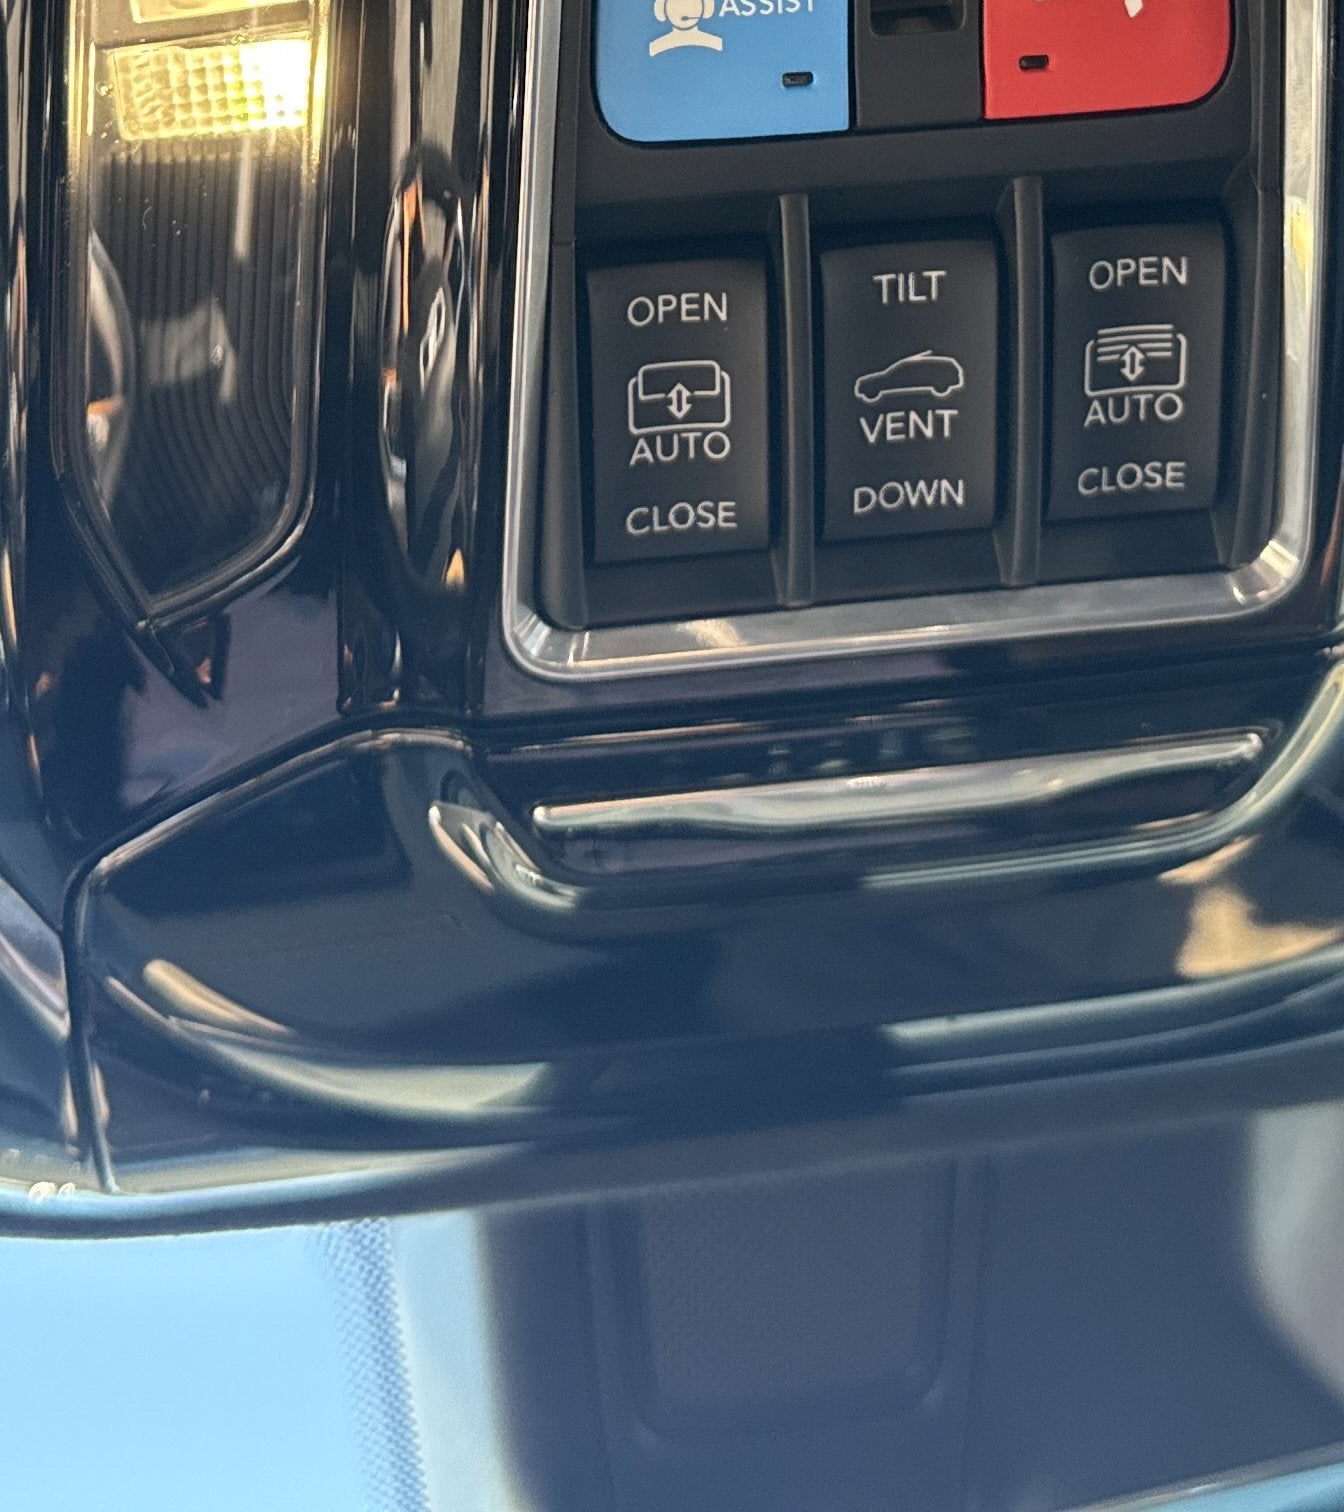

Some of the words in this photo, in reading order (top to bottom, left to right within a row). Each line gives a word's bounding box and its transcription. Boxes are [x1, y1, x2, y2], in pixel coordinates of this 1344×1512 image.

[873, 271, 946, 304] TILT
[1089, 256, 1188, 291] OPEN
[627, 292, 728, 326] OPEN
[859, 409, 958, 444] VENT
[1084, 393, 1183, 428] AUTO
[629, 431, 731, 466] AUTO
[1078, 461, 1186, 495] CLOSE
[853, 479, 964, 515] DOWN
[626, 501, 737, 535] CLOSE
